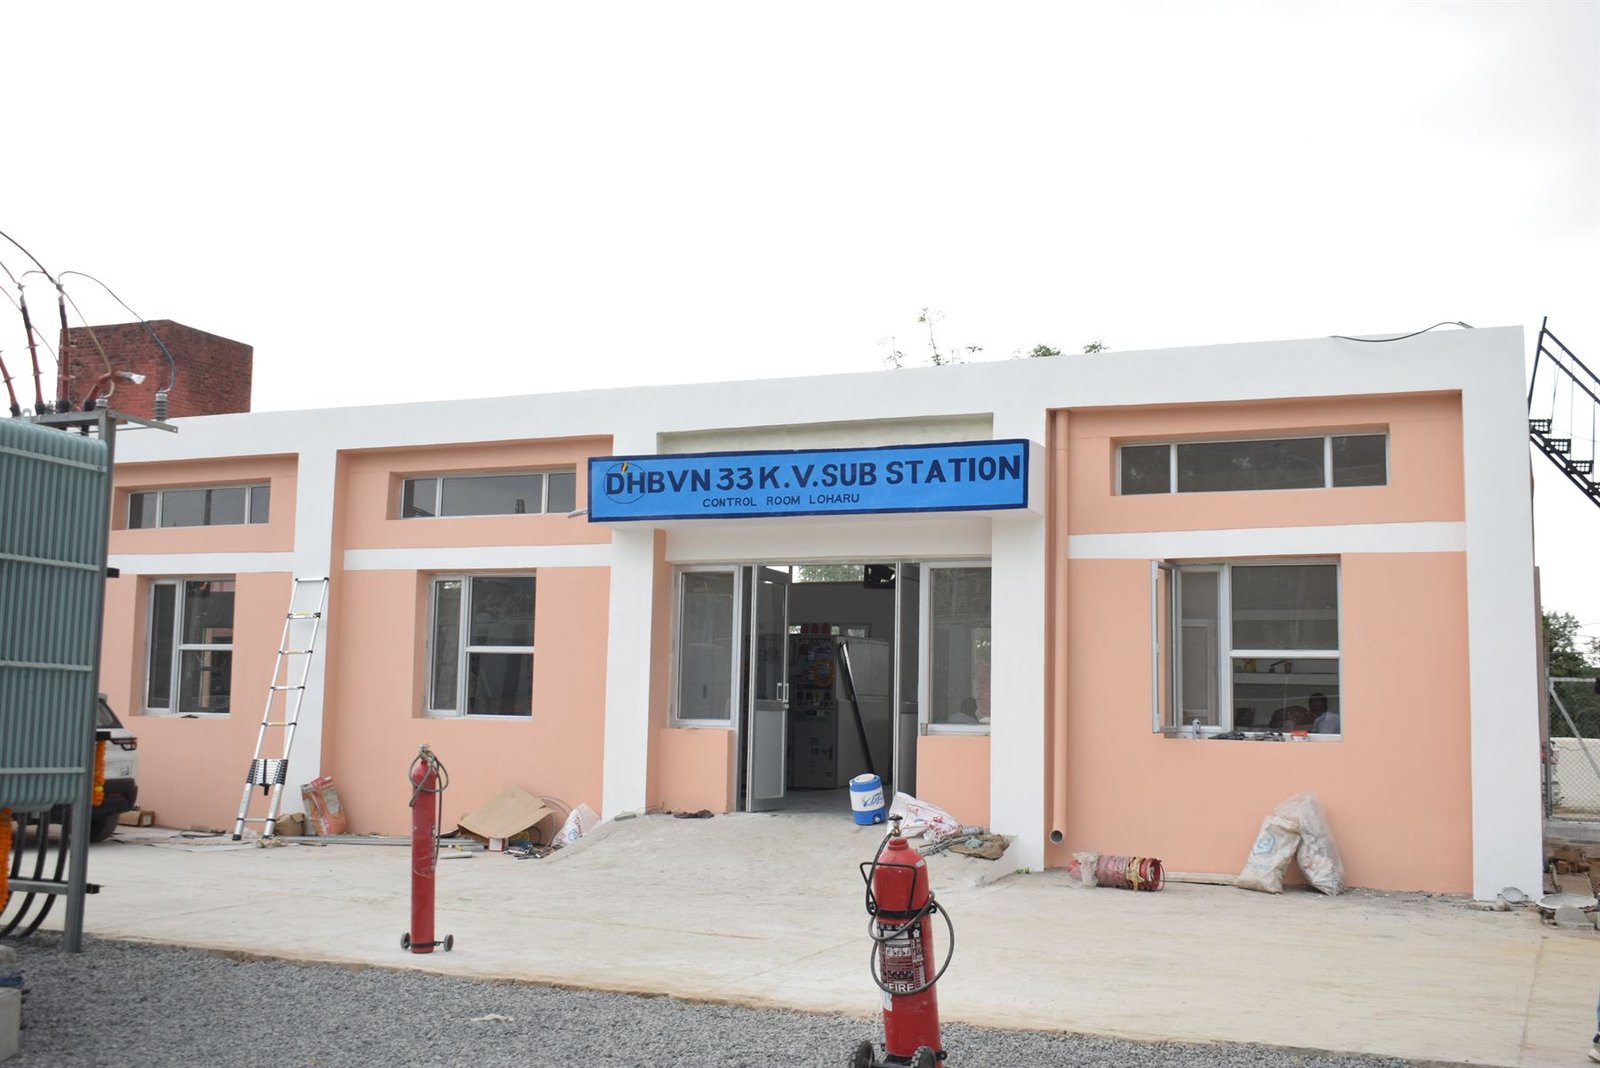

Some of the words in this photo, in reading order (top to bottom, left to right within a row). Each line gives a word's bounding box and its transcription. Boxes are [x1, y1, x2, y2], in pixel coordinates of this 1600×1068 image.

[606, 468, 711, 495] DHBVN
[886, 455, 1021, 485] STATION
[702, 497, 757, 508] CONTROL
[766, 495, 801, 506] ROOM
[809, 493, 860, 505] LOHARU
